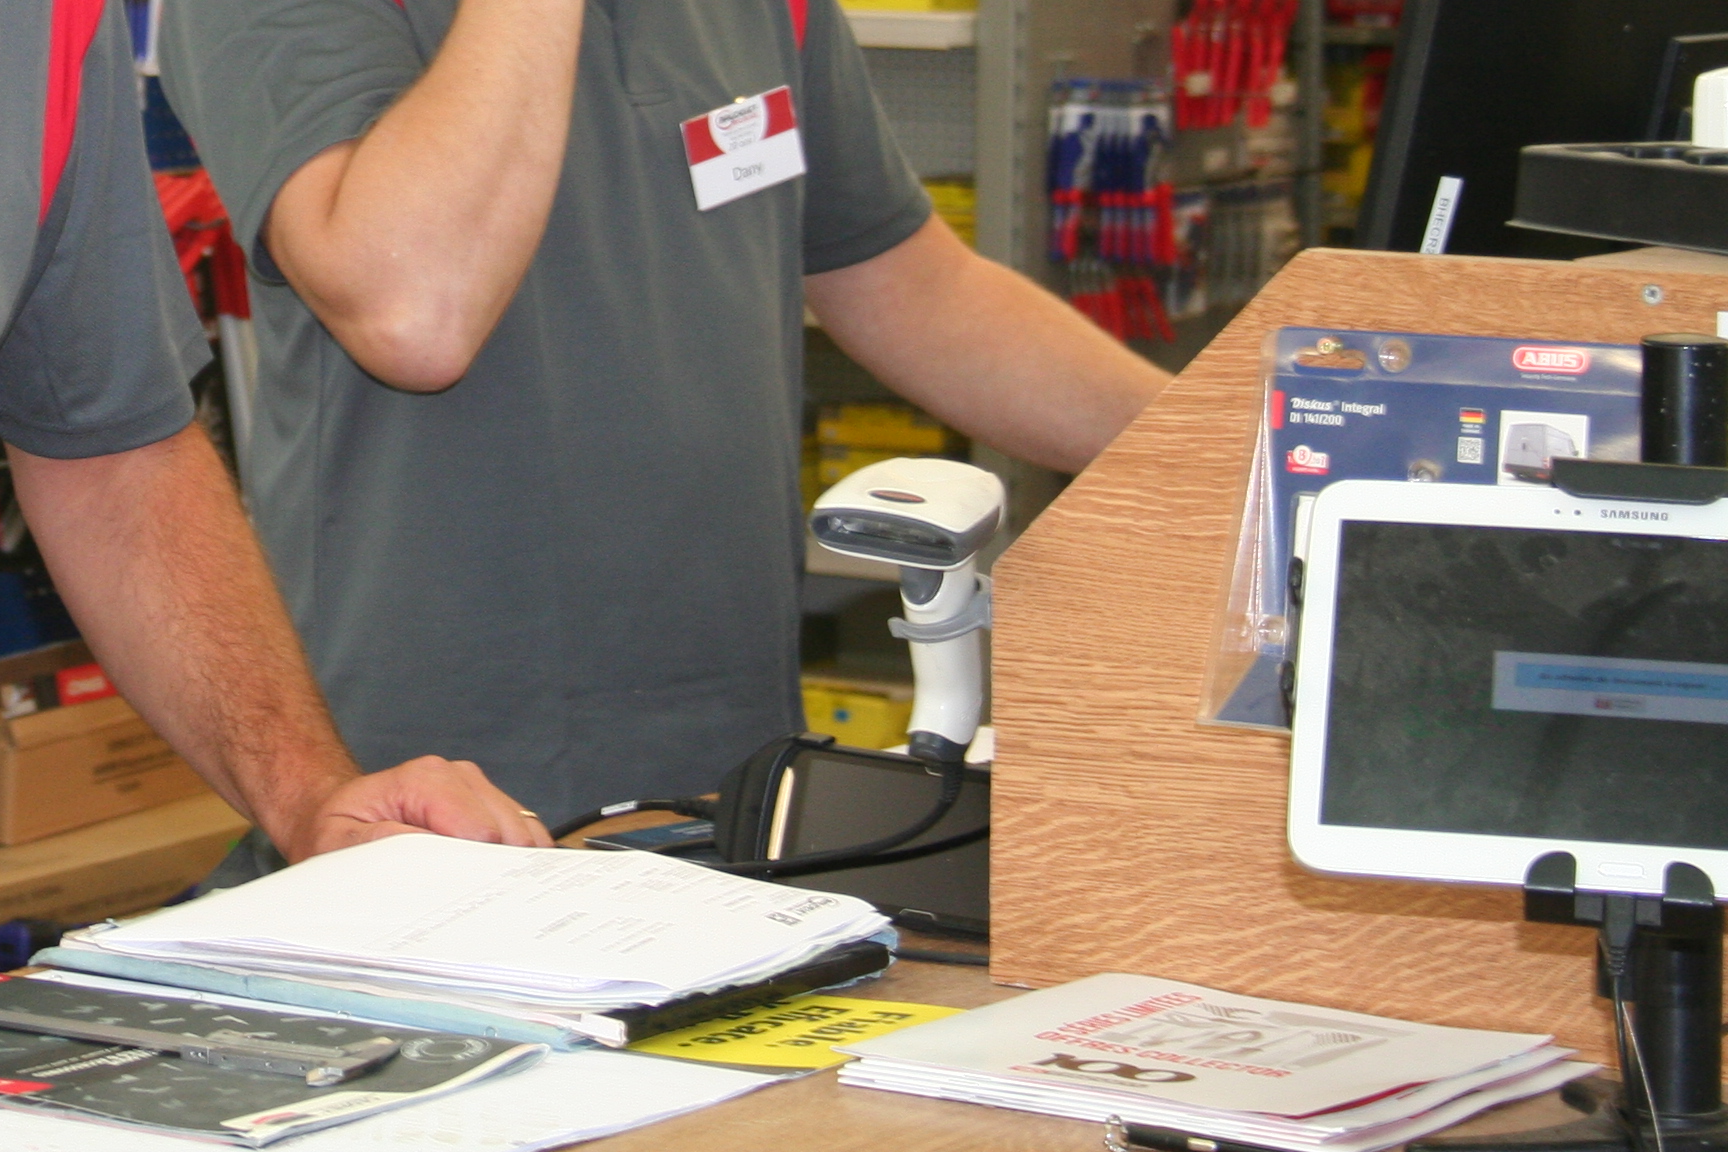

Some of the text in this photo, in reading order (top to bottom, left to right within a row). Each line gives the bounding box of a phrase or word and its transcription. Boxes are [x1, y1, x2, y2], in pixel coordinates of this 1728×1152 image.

[732, 162, 762, 181] Dany
[1522, 350, 1579, 369] ABUS
[1340, 401, 1386, 416] Integral
[1303, 412, 1343, 426] 141/200
[1599, 508, 1670, 522] SAMSUNG
[765, 1010, 912, 1048] Fiable.
[1136, 1050, 1293, 1078] COLLECTOR
